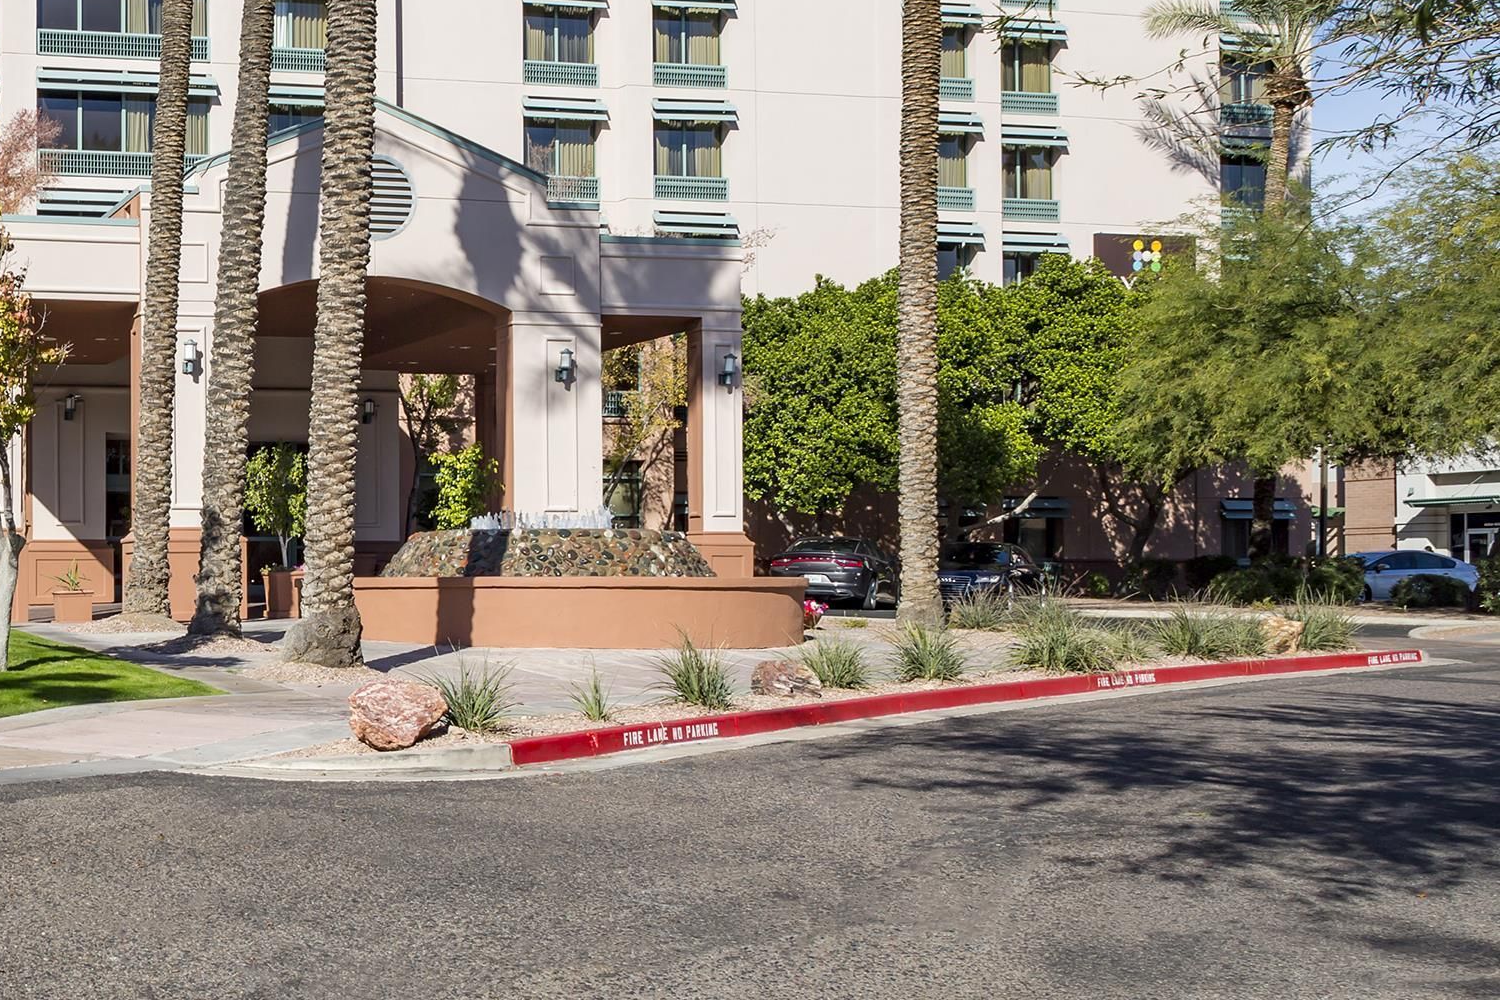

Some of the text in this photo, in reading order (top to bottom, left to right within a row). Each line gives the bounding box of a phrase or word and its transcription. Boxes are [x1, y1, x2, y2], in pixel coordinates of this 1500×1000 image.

[624, 723, 718, 745] FIRE LANE NO PARKING
